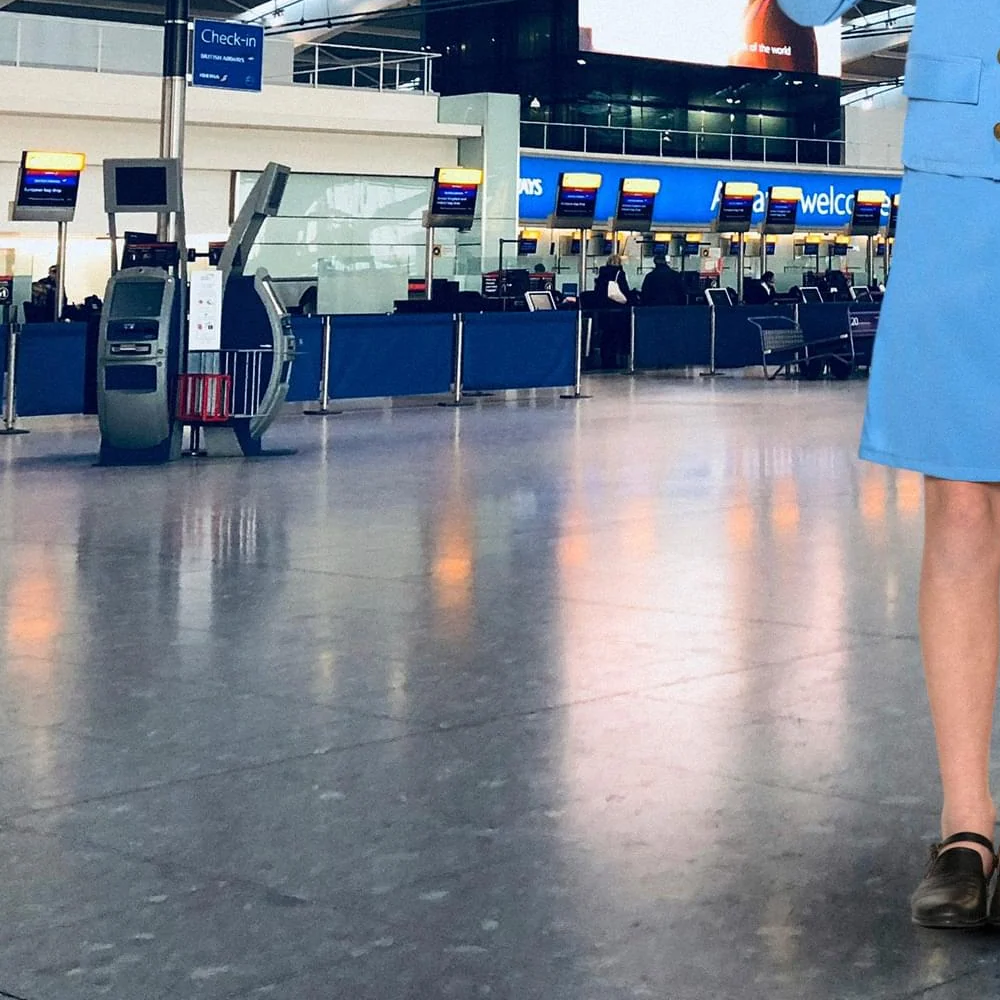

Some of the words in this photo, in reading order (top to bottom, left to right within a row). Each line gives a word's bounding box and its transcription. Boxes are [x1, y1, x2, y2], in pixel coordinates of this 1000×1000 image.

[201, 28, 257, 48] Check-in
[758, 43, 770, 54] the
[770, 45, 792, 57] world
[519, 177, 543, 196] AYS
[801, 185, 892, 216] welcoe
